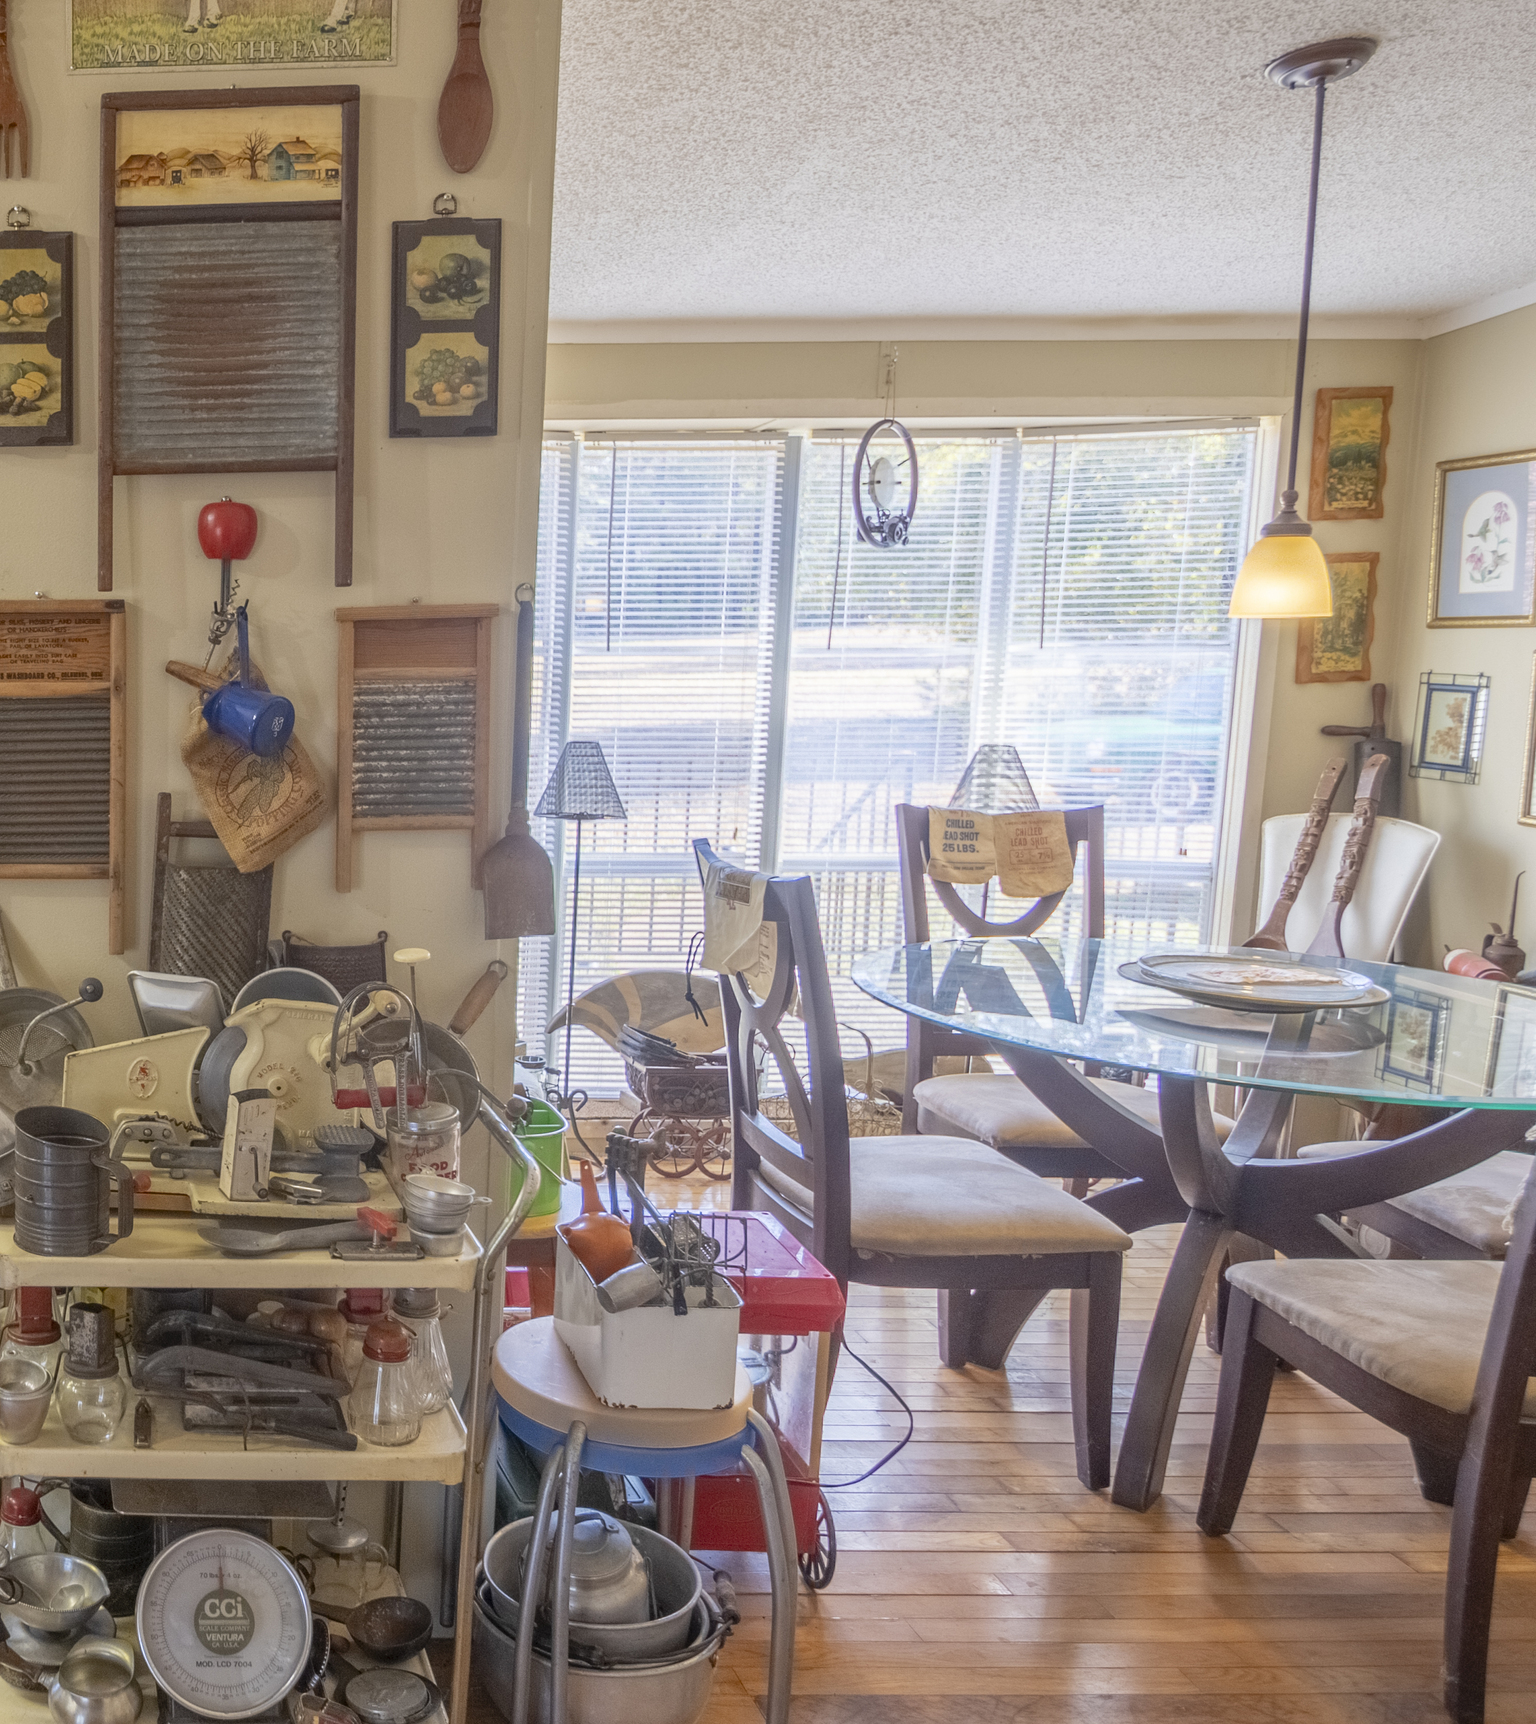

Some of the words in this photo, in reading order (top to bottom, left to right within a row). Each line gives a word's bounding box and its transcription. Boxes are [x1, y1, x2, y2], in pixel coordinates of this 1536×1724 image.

[102, 42, 177, 63] MADE
[185, 41, 225, 61] ON
[231, 40, 283, 60] THE
[290, 38, 364, 59] FARM
[7, 626, 17, 634] OR
[6, 672, 45, 680] WASHBOARD
[290, 757, 304, 795] CORN
[945, 818, 975, 829] CHILLED
[959, 831, 980, 841] SHOT
[1015, 826, 1043, 837] CHILLED
[1010, 837, 1028, 847] LEAD
[1030, 836, 1049, 847] SHOT
[942, 843, 955, 853] 25
[957, 844, 980, 853] LBS.
[285, 1010, 326, 1021] GENERAL
[256, 1062, 285, 1079] MODEL
[409, 1161, 448, 1172] FOD
[204, 1596, 244, 1618] CCi
[206, 1633, 244, 1641] VENTURA
[196, 1660, 215, 1668] MOD.
[216, 1660, 232, 1668] LCD
[233, 1660, 253, 1668] 7004
